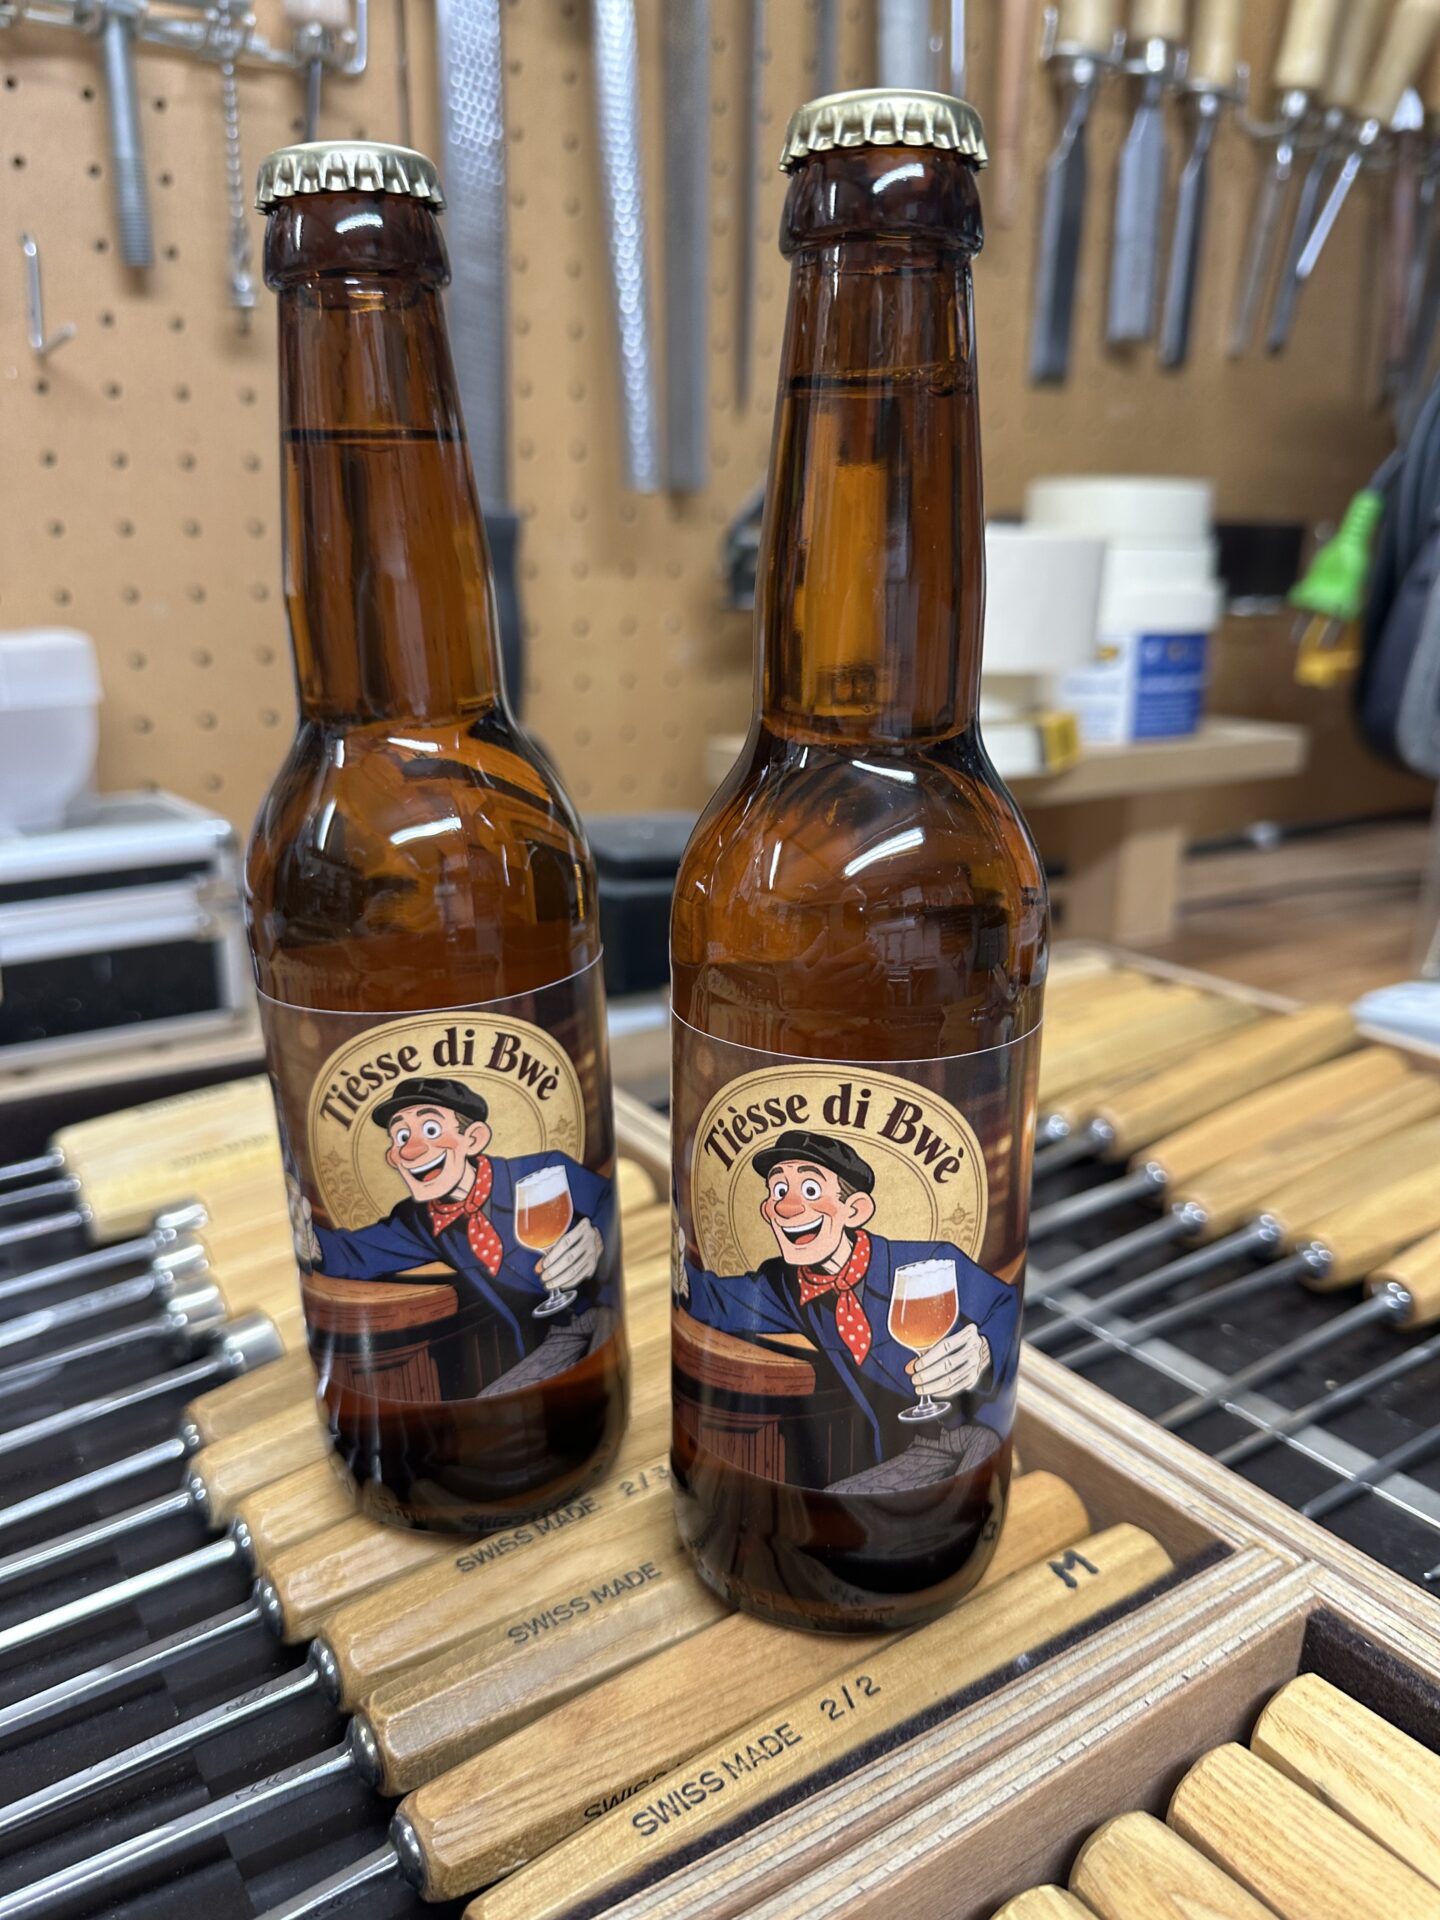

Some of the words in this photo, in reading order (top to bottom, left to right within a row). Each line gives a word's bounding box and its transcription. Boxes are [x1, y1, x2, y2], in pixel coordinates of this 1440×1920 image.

[319, 1044, 422, 1131] Tièsse
[432, 1026, 475, 1066] di
[485, 1031, 561, 1101] Bwè
[704, 1094, 810, 1171] Tièsse
[823, 1083, 872, 1129] di
[877, 1097, 964, 1184] Bwè
[456, 1526, 534, 1573] SWISS
[534, 1496, 602, 1535] MADE
[1046, 1549, 1099, 1589] M
[507, 1596, 591, 1644] SWISS
[591, 1561, 662, 1604] MADE
[632, 1770, 725, 1836] SWISS
[720, 1722, 803, 1780] MADE
[820, 1675, 881, 1721] 2/2
